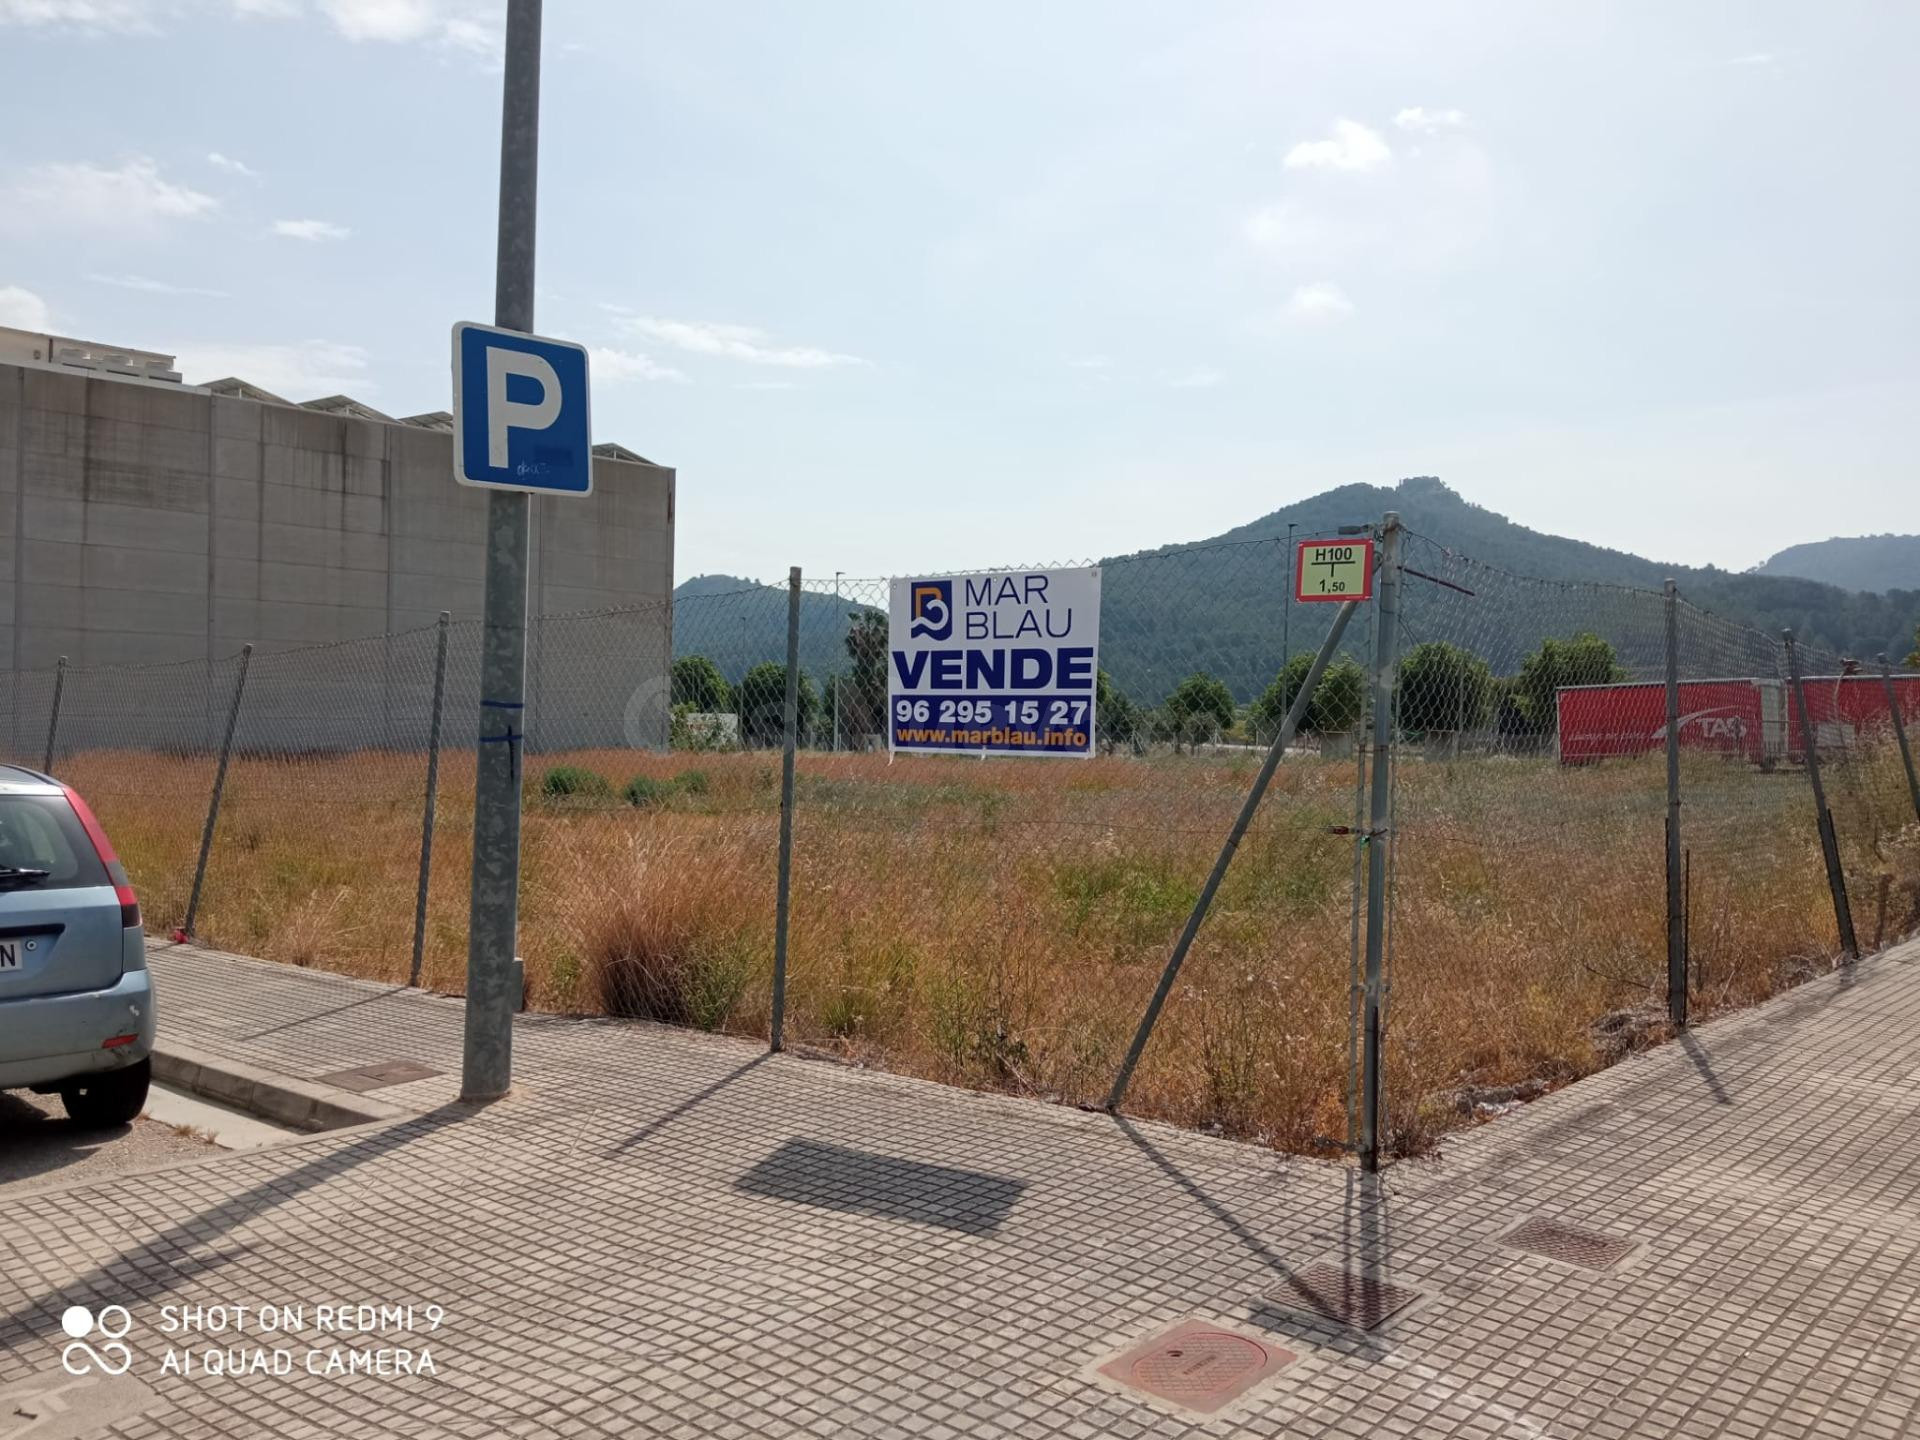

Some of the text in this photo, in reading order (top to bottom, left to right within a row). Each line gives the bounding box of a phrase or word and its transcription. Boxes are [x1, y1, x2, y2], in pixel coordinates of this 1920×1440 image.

[486, 346, 562, 468] P
[1315, 547, 1352, 561] H100
[965, 575, 1048, 606] MAR
[1319, 579, 1345, 593] 1,50
[966, 608, 1072, 640] BLAU
[892, 647, 1093, 689] VENDE
[896, 700, 1088, 725] 96 295 15 27
[896, 726, 1087, 747] www.marblau.info
